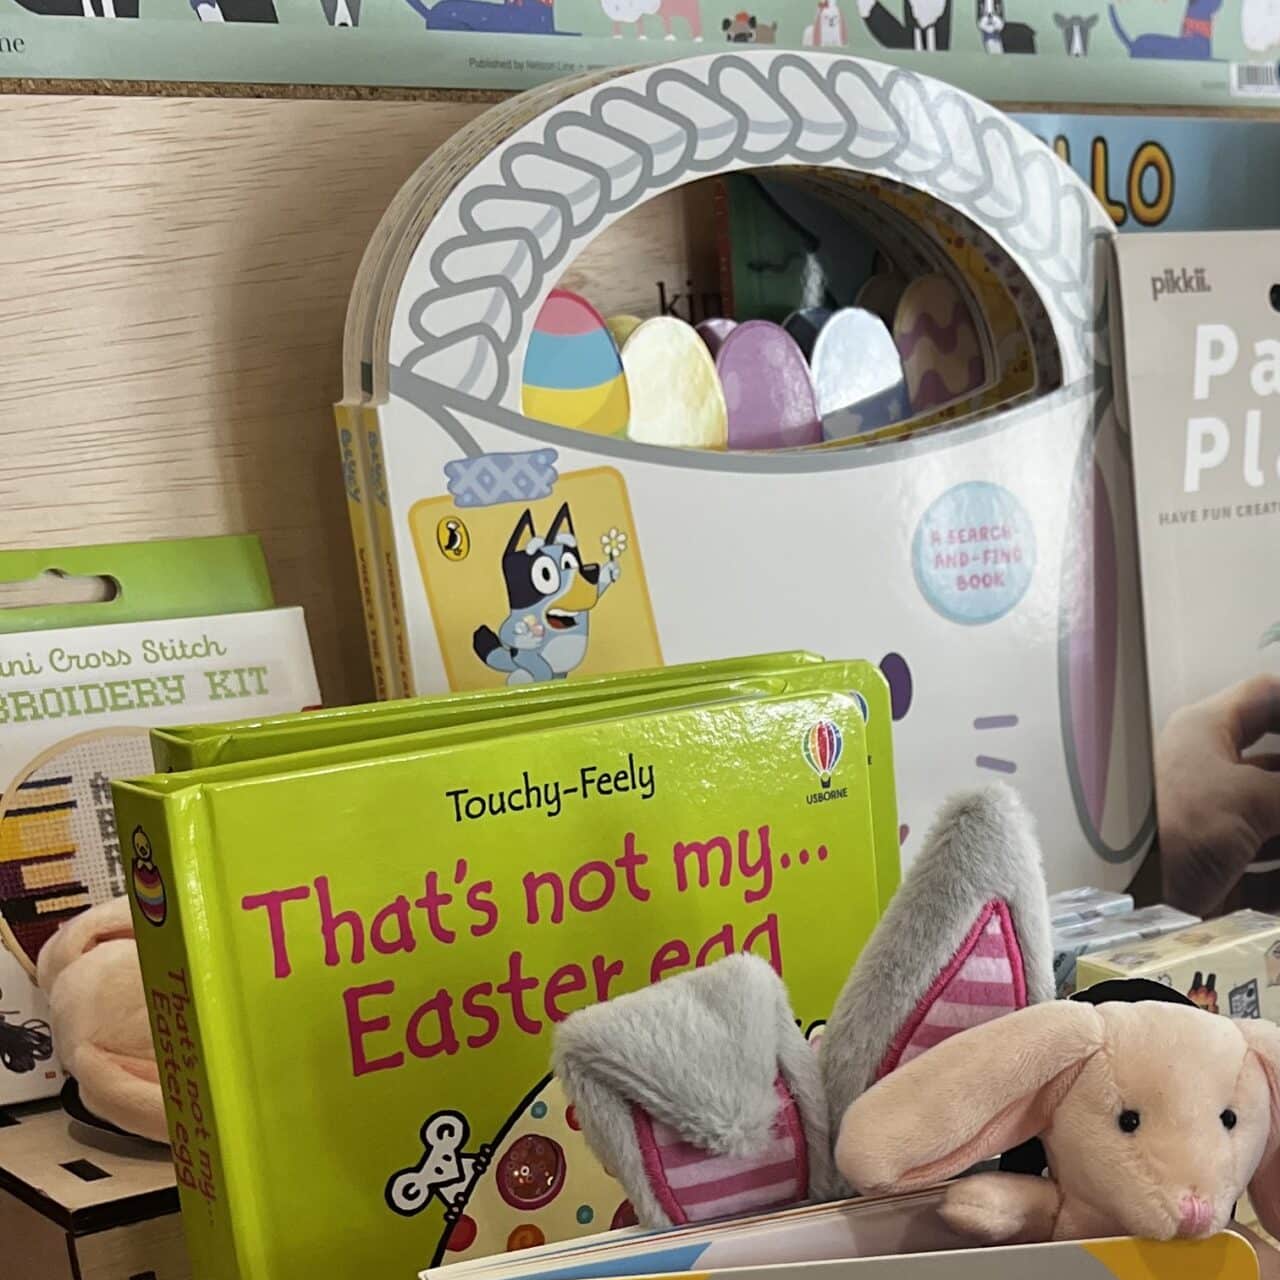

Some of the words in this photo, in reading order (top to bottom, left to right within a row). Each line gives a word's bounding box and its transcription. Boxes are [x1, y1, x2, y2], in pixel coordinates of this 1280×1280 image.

[1035, 134, 1176, 228] LO
[1158, 509, 1198, 526] HAVE
[1201, 504, 1232, 522] FUN
[955, 571, 1006, 592] BOOK
[49, 647, 132, 673] Cross
[141, 634, 227, 665] Stitch
[204, 665, 270, 701] KIT
[445, 753, 656, 822] Touchy-Feely
[805, 787, 849, 805] USBORNE
[241, 858, 500, 979] That's
[523, 831, 652, 925] not
[673, 824, 829, 903] my...
[342, 950, 624, 1078] Easter
[151, 988, 184, 1113] Easter
[174, 1123, 199, 1192] egg
[186, 1078, 211, 1140] not
